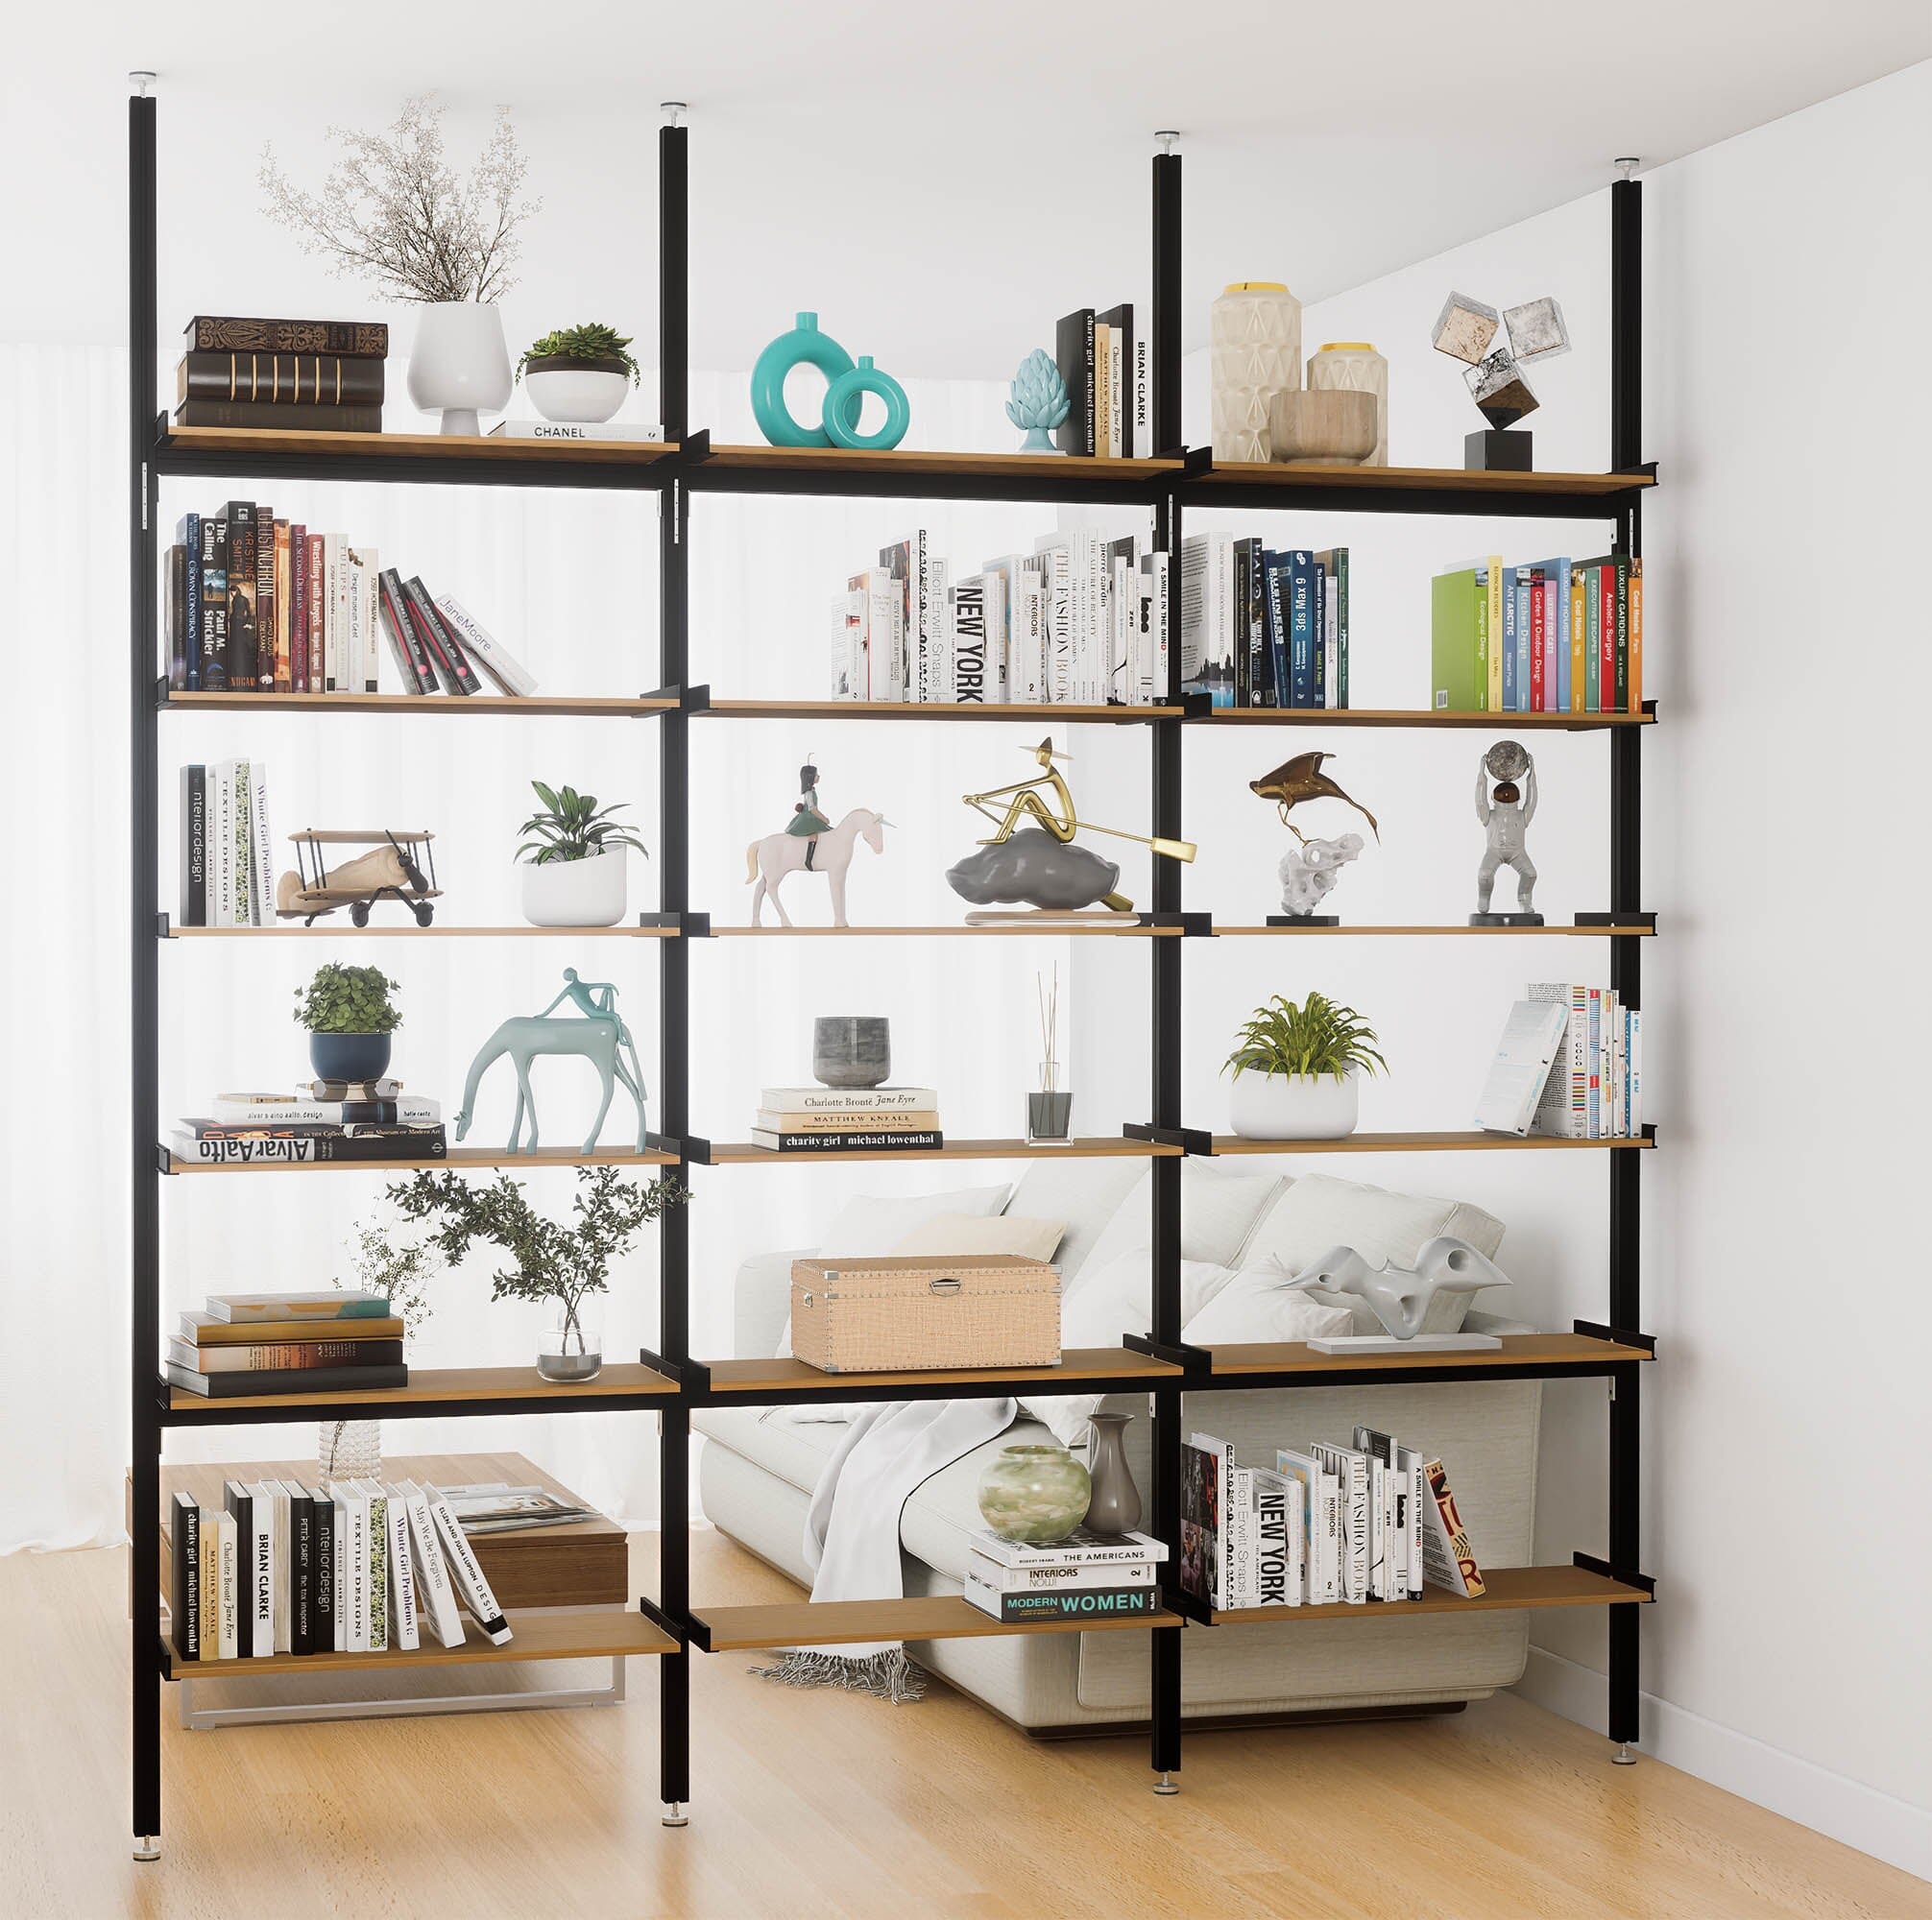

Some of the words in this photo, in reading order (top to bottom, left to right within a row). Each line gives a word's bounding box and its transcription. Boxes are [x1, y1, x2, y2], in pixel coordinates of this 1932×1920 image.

[1086, 315, 1095, 347] charity
[1086, 349, 1095, 366] girl
[534, 427, 586, 438] CHANEL
[1113, 408, 1122, 425] Jane
[203, 522, 214, 562] Calling
[217, 522, 227, 543] The
[232, 540, 242, 572] SMITH
[246, 531, 254, 580] KRISTINE
[311, 540, 323, 579] Wrestling
[1056, 551, 1069, 584] THE
[311, 581, 323, 599] with
[930, 561, 944, 601] Elliott
[1618, 564, 1627, 601] LUXURY
[311, 600, 323, 627] Angels
[956, 588, 983, 637] NEW
[1160, 601, 1168, 610] IN
[1296, 587, 1307, 610] Max
[1518, 592, 1529, 627] Kitchen
[205, 610, 214, 657] Strickler
[217, 610, 227, 635] Paul
[930, 602, 944, 638] Erwitt
[1056, 588, 1069, 655] FASHION
[1296, 612, 1307, 632] 3ds
[1618, 603, 1627, 648] GARDENS
[217, 637, 227, 652] M.
[1518, 630, 1529, 660] Design
[1606, 628, 1614, 661] Surgery
[930, 643, 944, 688] Snaps
[956, 644, 983, 704] YORK
[1056, 659, 1069, 703] BOOK
[259, 825, 269, 847] Girl
[262, 850, 273, 901] Problems
[805, 1097, 844, 1107] Charlotte
[875, 1093, 896, 1107] Jane
[898, 1092, 916, 1106] Eyre
[200, 1140, 254, 1162] Aalto
[256, 1140, 309, 1161] Alvar
[786, 1135, 820, 1147] charity
[822, 1135, 842, 1146] girl
[847, 1135, 884, 1145] michael
[887, 1133, 934, 1145] lowenthal
[1354, 1457, 1365, 1489] THE
[1237, 1473, 1249, 1508] Elliott
[1415, 1500, 1422, 1508] IN
[185, 1513, 198, 1546] charity
[300, 1518, 309, 1541] PETER
[415, 1505, 425, 1524] May
[1237, 1510, 1249, 1547] Erwitt
[1260, 1494, 1286, 1541] NEW
[1354, 1493, 1365, 1556] FASHION
[421, 1526, 429, 1540] We
[426, 1540, 434, 1552] Be
[439, 1507, 450, 1525] ELLEN
[447, 1524, 458, 1541] AND
[454, 1540, 467, 1558] JULIA
[462, 1557, 479, 1583] LUPTON
[186, 1548, 198, 1565] girl
[224, 1542, 232, 1574] Charlotte
[258, 1534, 270, 1572] BRIAN
[300, 1543, 309, 1568] CAREY
[400, 1554, 410, 1575] Girl
[1063, 1553, 1082, 1562] THE
[1087, 1551, 1146, 1561] AMERICANS
[299, 1574, 308, 1587] the
[429, 1553, 443, 1590] Forgiven
[1029, 1568, 1079, 1579] INTERIORS
[1237, 1550, 1249, 1594] Snaps
[1260, 1546, 1286, 1605] YORK
[1354, 1559, 1365, 1601] BOOK
[187, 1571, 198, 1606] michael
[258, 1575, 270, 1620] CLARKE
[299, 1589, 308, 1600] tax
[402, 1577, 414, 1626] Problems
[1007, 1596, 1058, 1610] MODERN
[1061, 1594, 1144, 1613] WOMEN
[224, 1604, 234, 1621] Jane
[299, 1602, 308, 1636] inspector
[187, 1608, 198, 1652] lowenthal
[224, 1623, 234, 1640] Eyre
